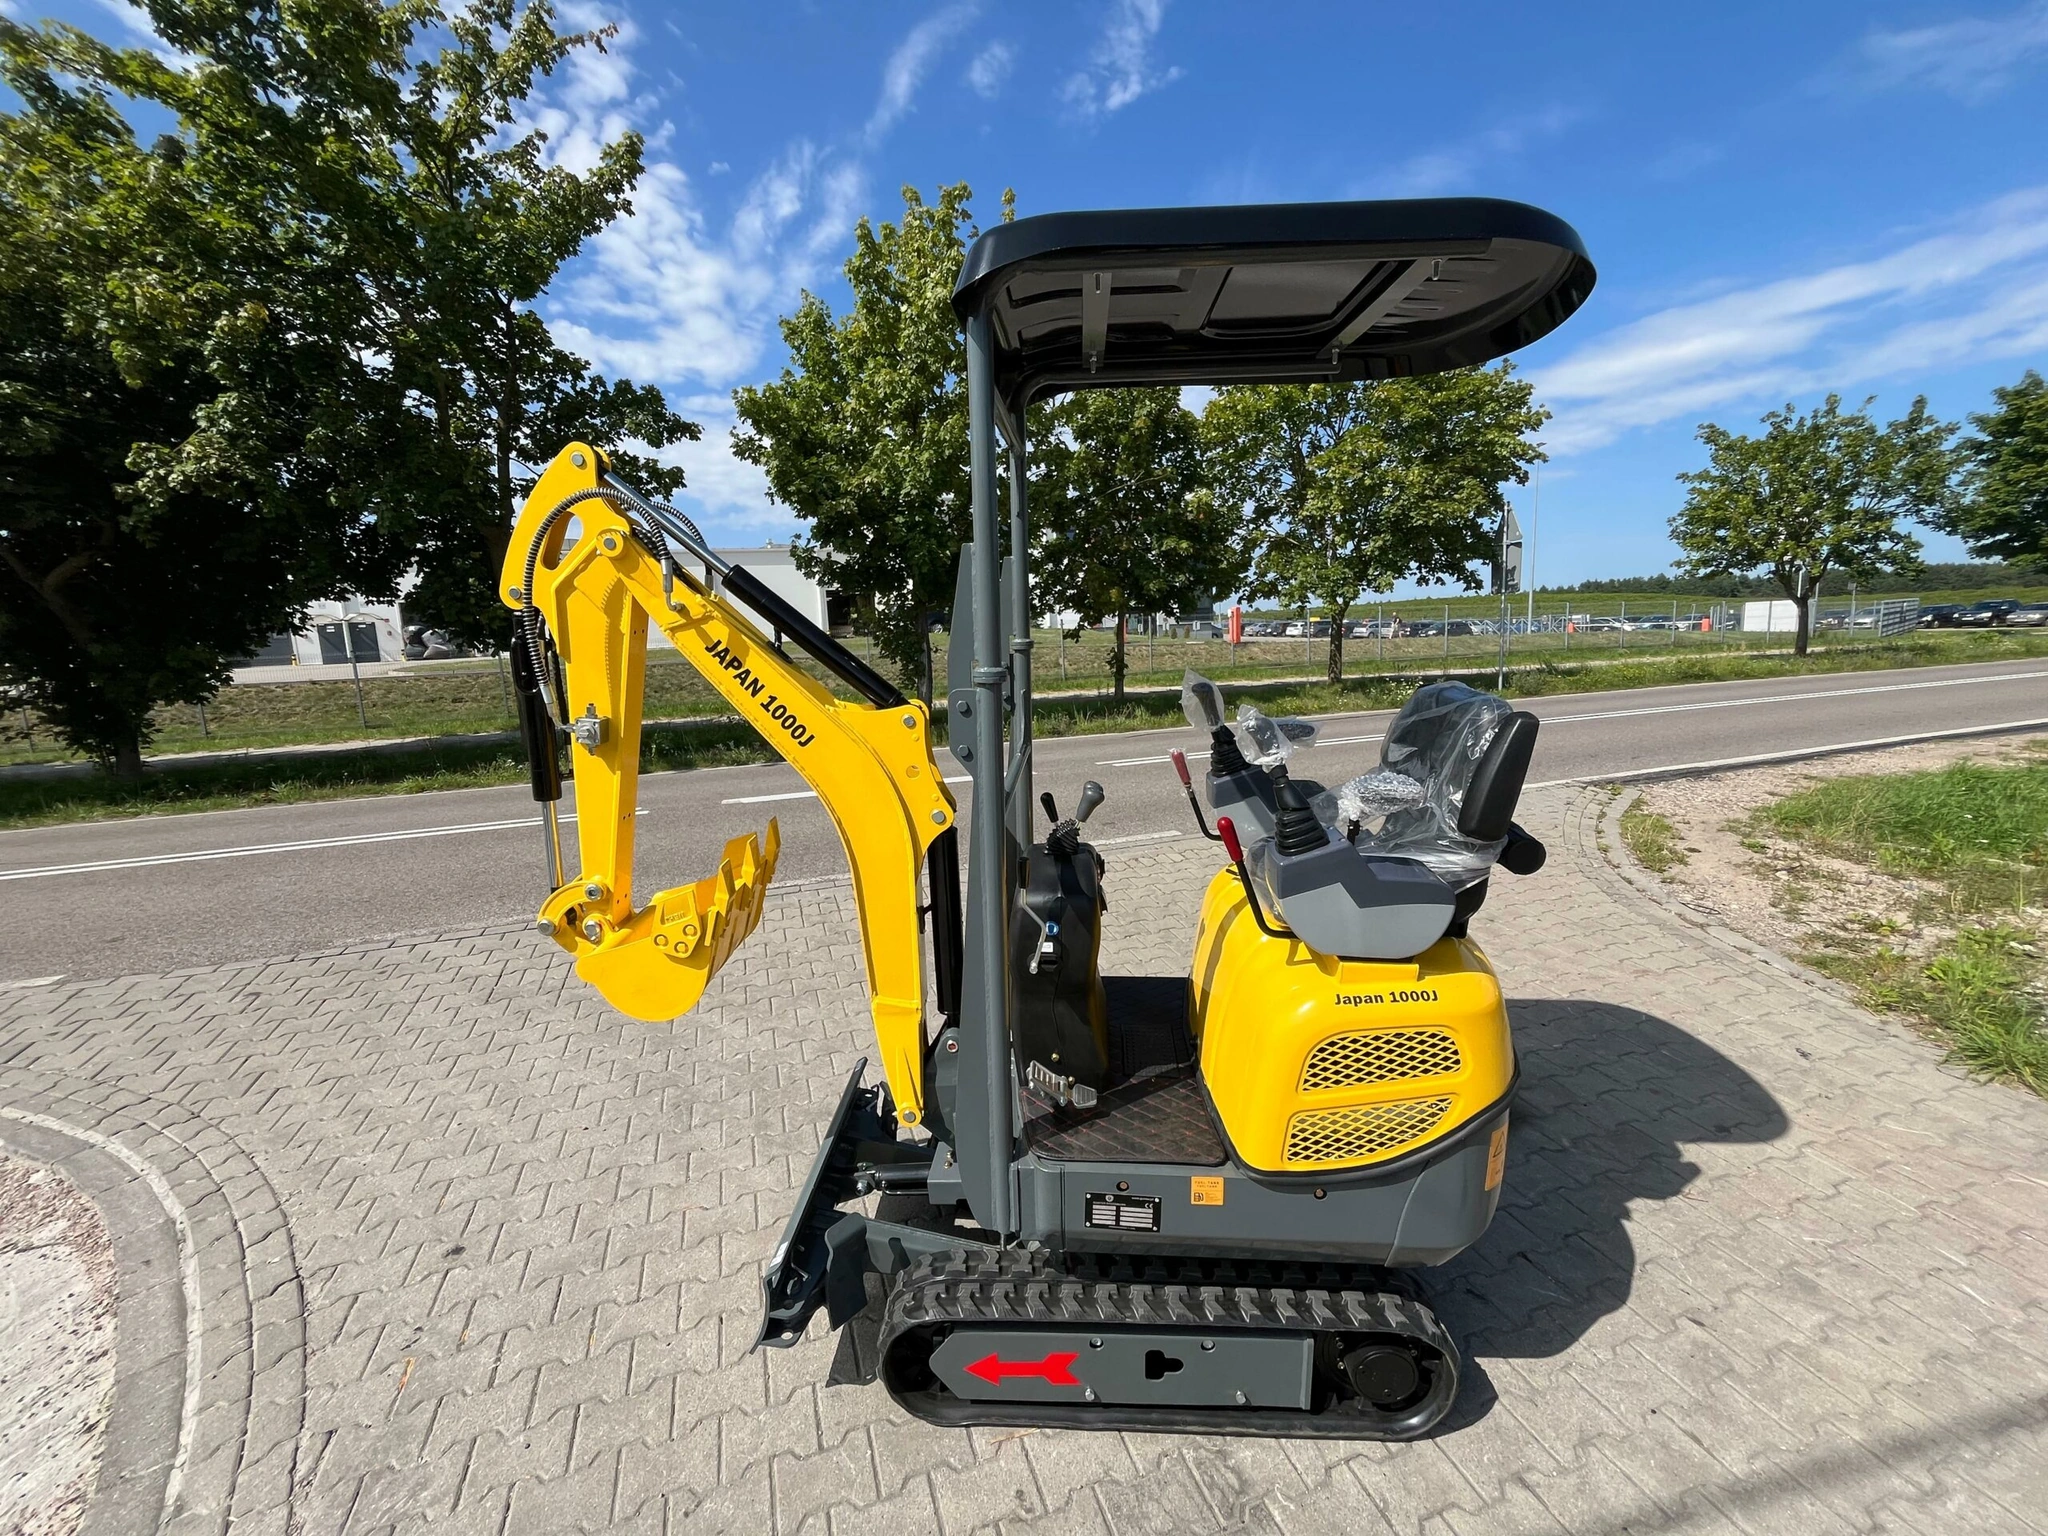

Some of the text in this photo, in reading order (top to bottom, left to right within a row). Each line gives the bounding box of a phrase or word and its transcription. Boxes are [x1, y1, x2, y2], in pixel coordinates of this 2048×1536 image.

[704, 639, 816, 748] JAPAN 1000J
[1334, 989, 1439, 1007] Japan 1000J
